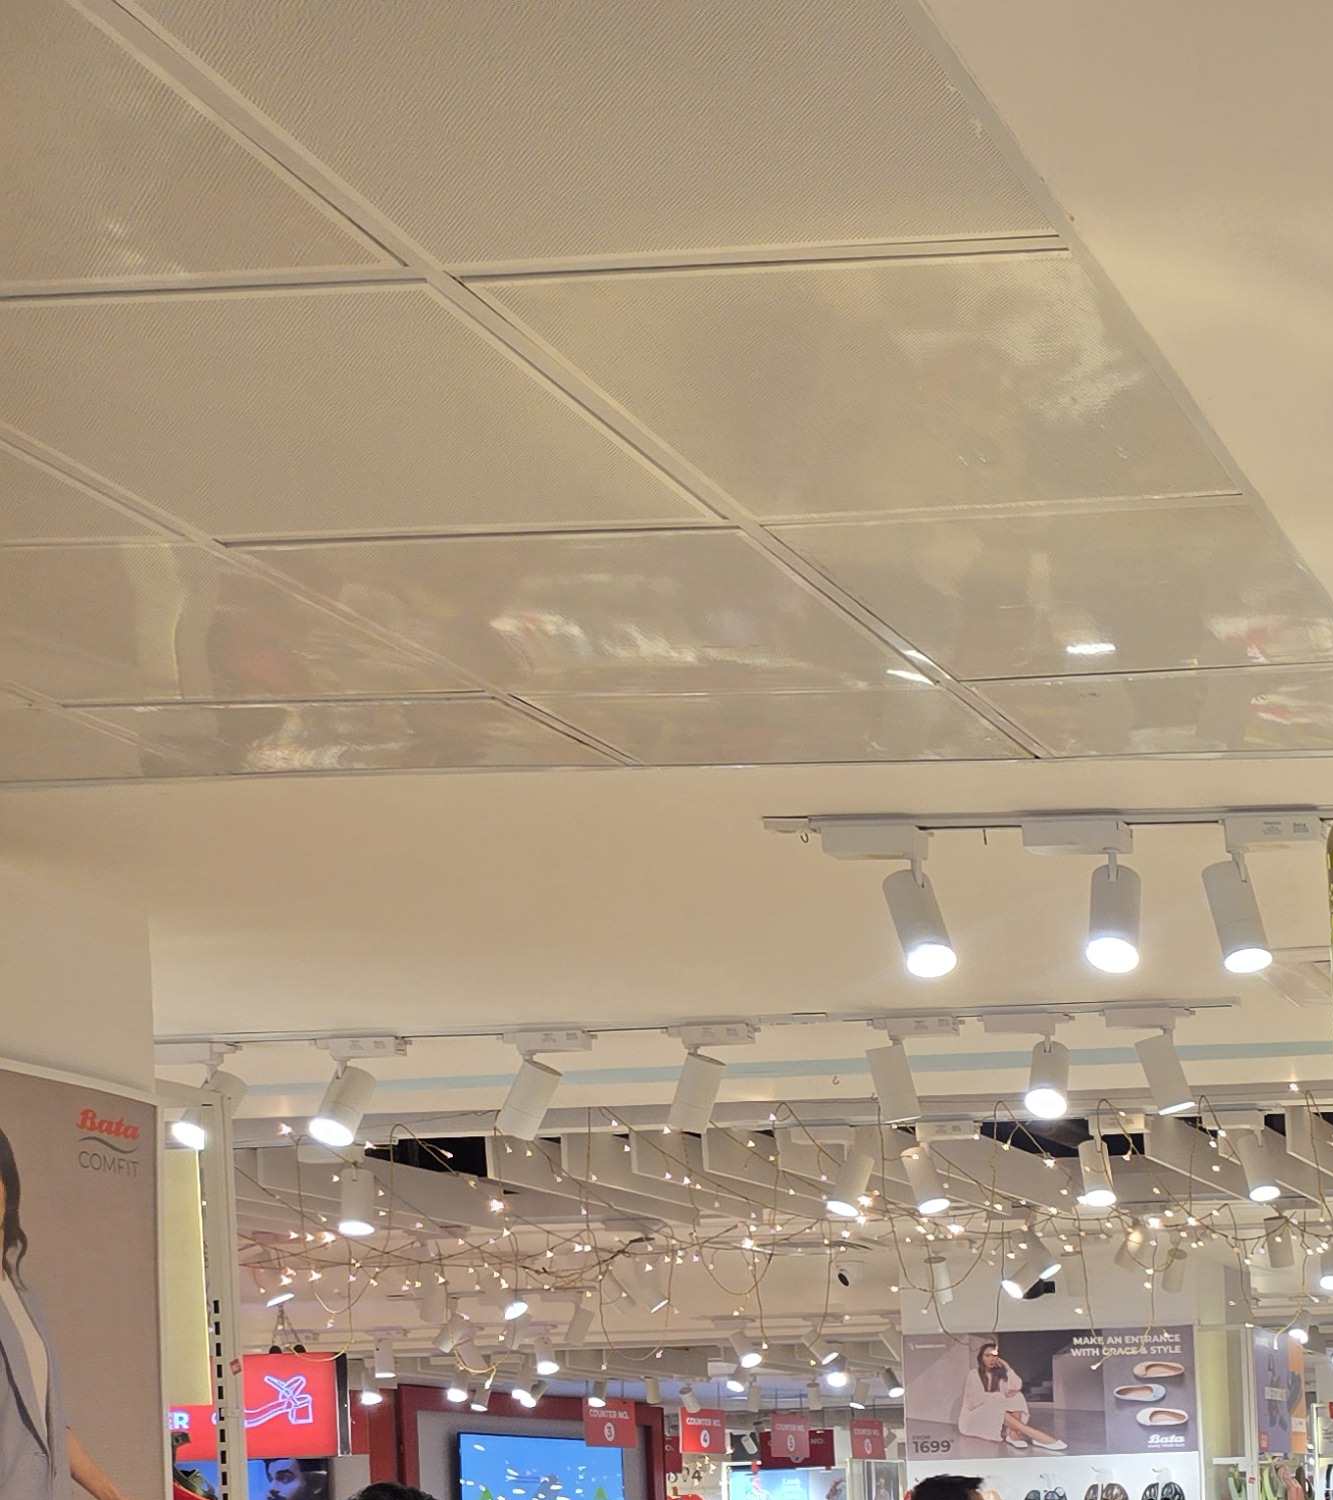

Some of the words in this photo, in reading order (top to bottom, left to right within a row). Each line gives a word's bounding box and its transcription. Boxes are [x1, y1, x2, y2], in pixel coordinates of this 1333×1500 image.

[77, 1109, 139, 1140] Bata
[79, 1151, 139, 1177] COMFIT
[1073, 1337, 1104, 1345] MAKE
[1107, 1336, 1122, 1344] AN
[1125, 1334, 1181, 1343] ENTRANCE
[1071, 1348, 1099, 1357] WITH
[1150, 1346, 1182, 1354] STYLE
[589, 1409, 616, 1418] COUNTER
[686, 1417, 711, 1425] COUNTER
[1148, 1434, 1185, 1443] Bata
[913, 1440, 951, 1453] 1699
